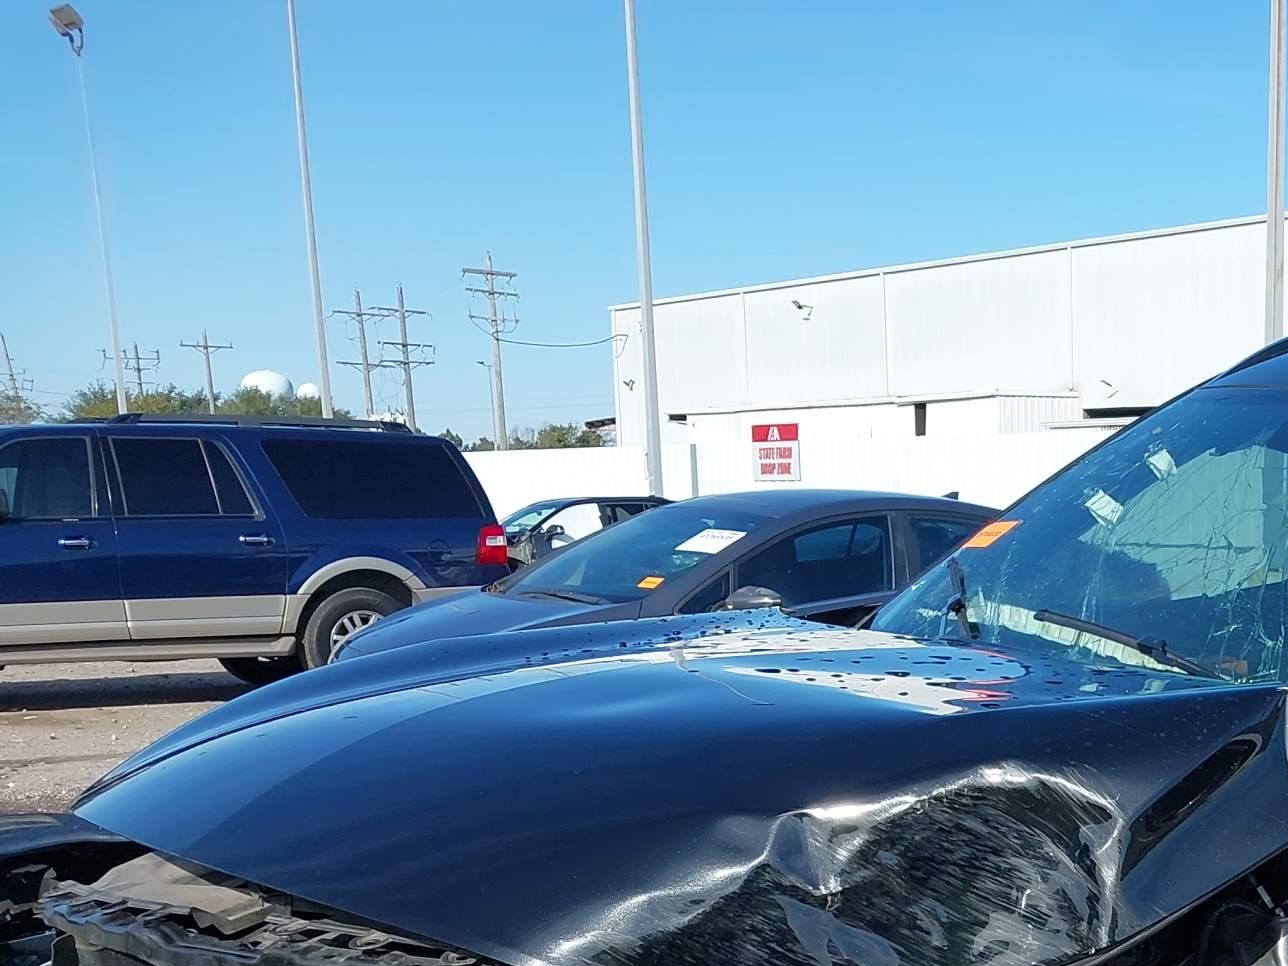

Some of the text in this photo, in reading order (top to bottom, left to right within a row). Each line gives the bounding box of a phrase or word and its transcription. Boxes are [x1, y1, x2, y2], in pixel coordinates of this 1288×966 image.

[758, 447, 792, 460] STATE FARM
[760, 462, 792, 475] DROP ZONE
